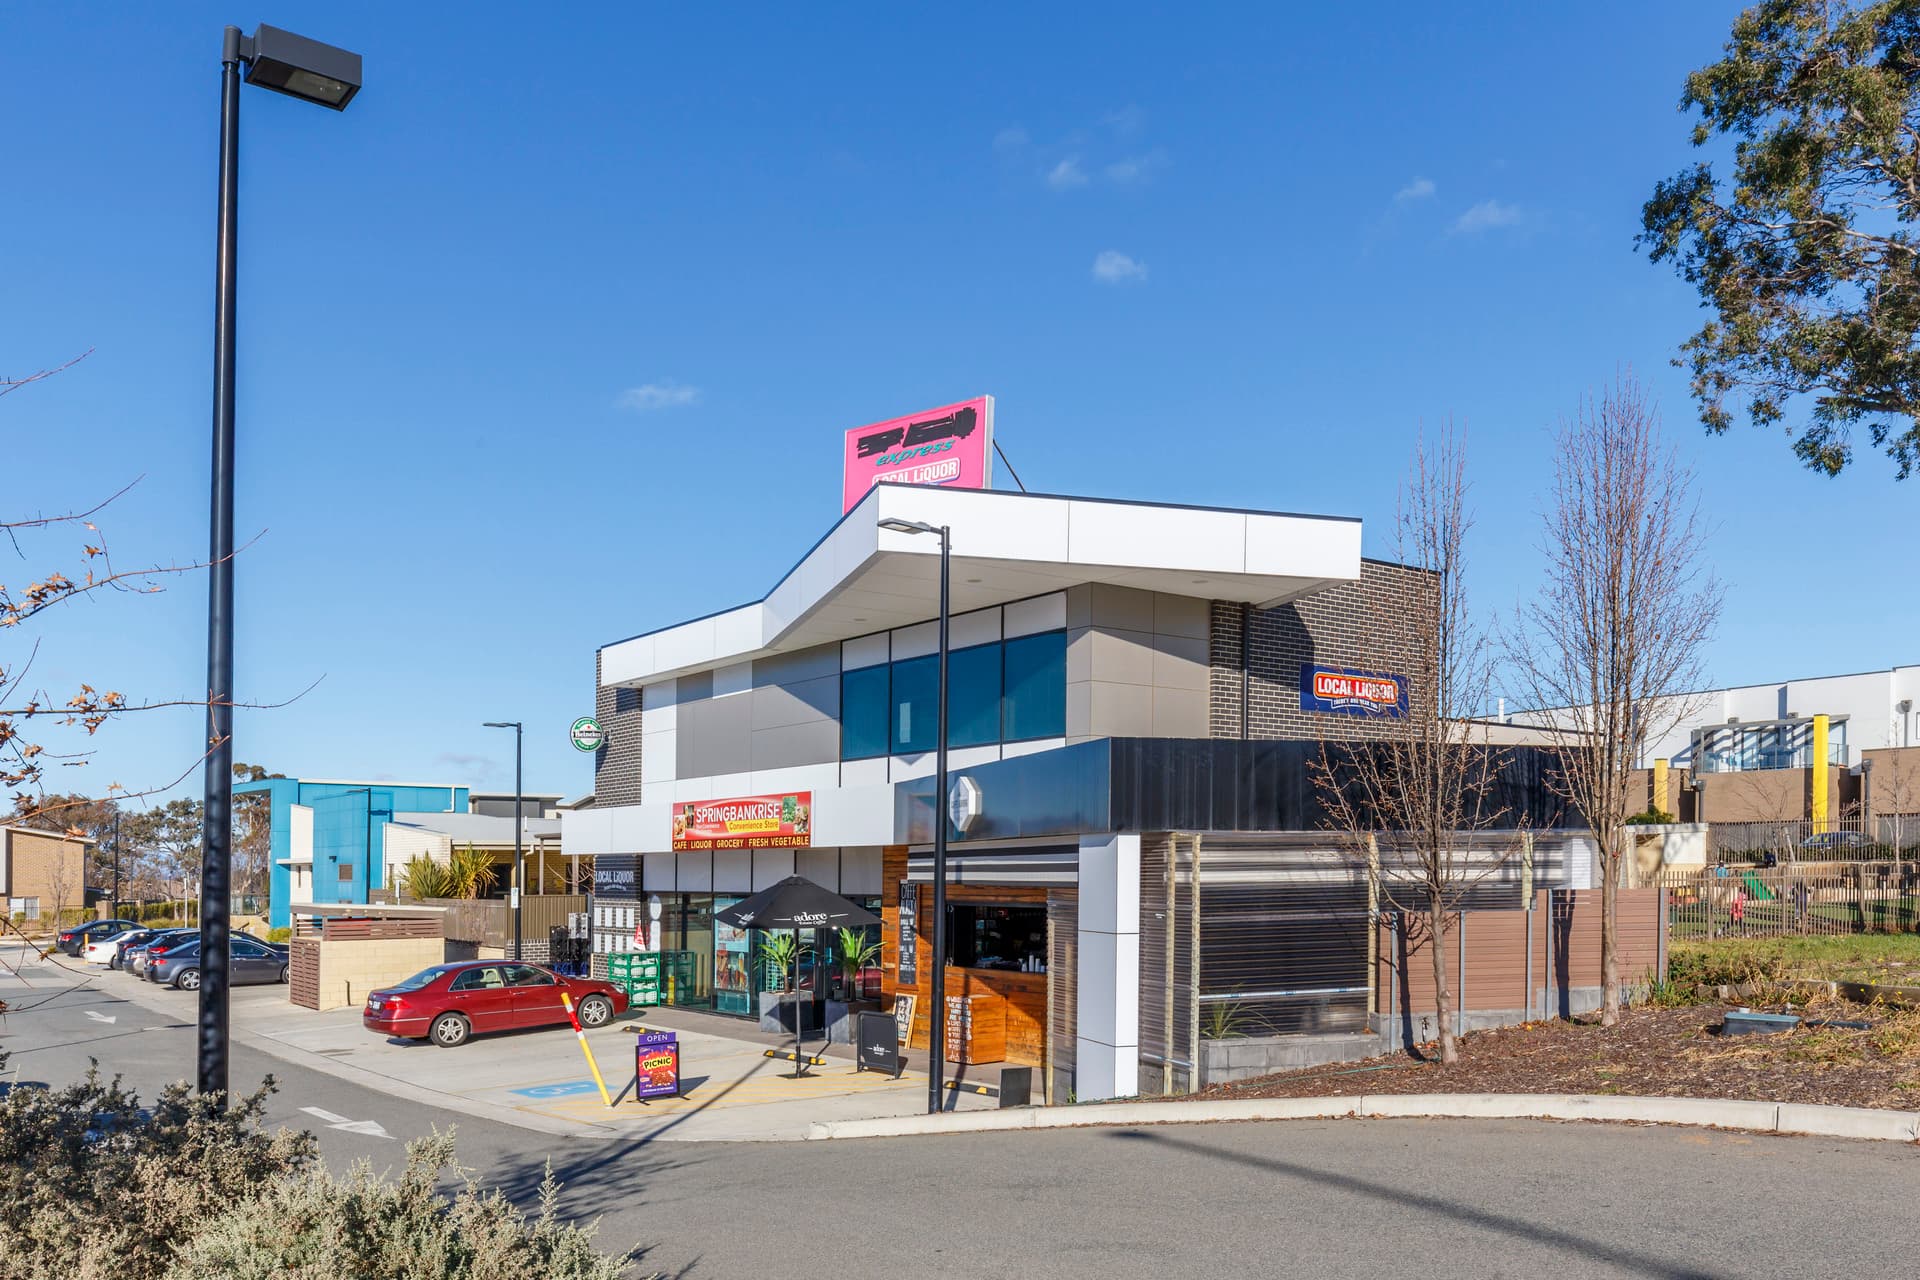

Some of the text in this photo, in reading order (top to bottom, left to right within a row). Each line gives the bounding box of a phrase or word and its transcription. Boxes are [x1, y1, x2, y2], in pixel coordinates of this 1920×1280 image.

[875, 439, 955, 466] express
[1317, 677, 1352, 696] LOCAL
[695, 803, 780, 823] SPRINGBANKRISE
[728, 820, 763, 831] Convenience
[764, 819, 779, 829] Store
[673, 836, 809, 849] CAFE LIQUOR GROCERY FRESH VEGETABLE
[595, 871, 612, 883] LOCAL
[793, 911, 829, 922] adore
[646, 1033, 668, 1042] OPEN
[642, 1057, 672, 1070] PICNIC
